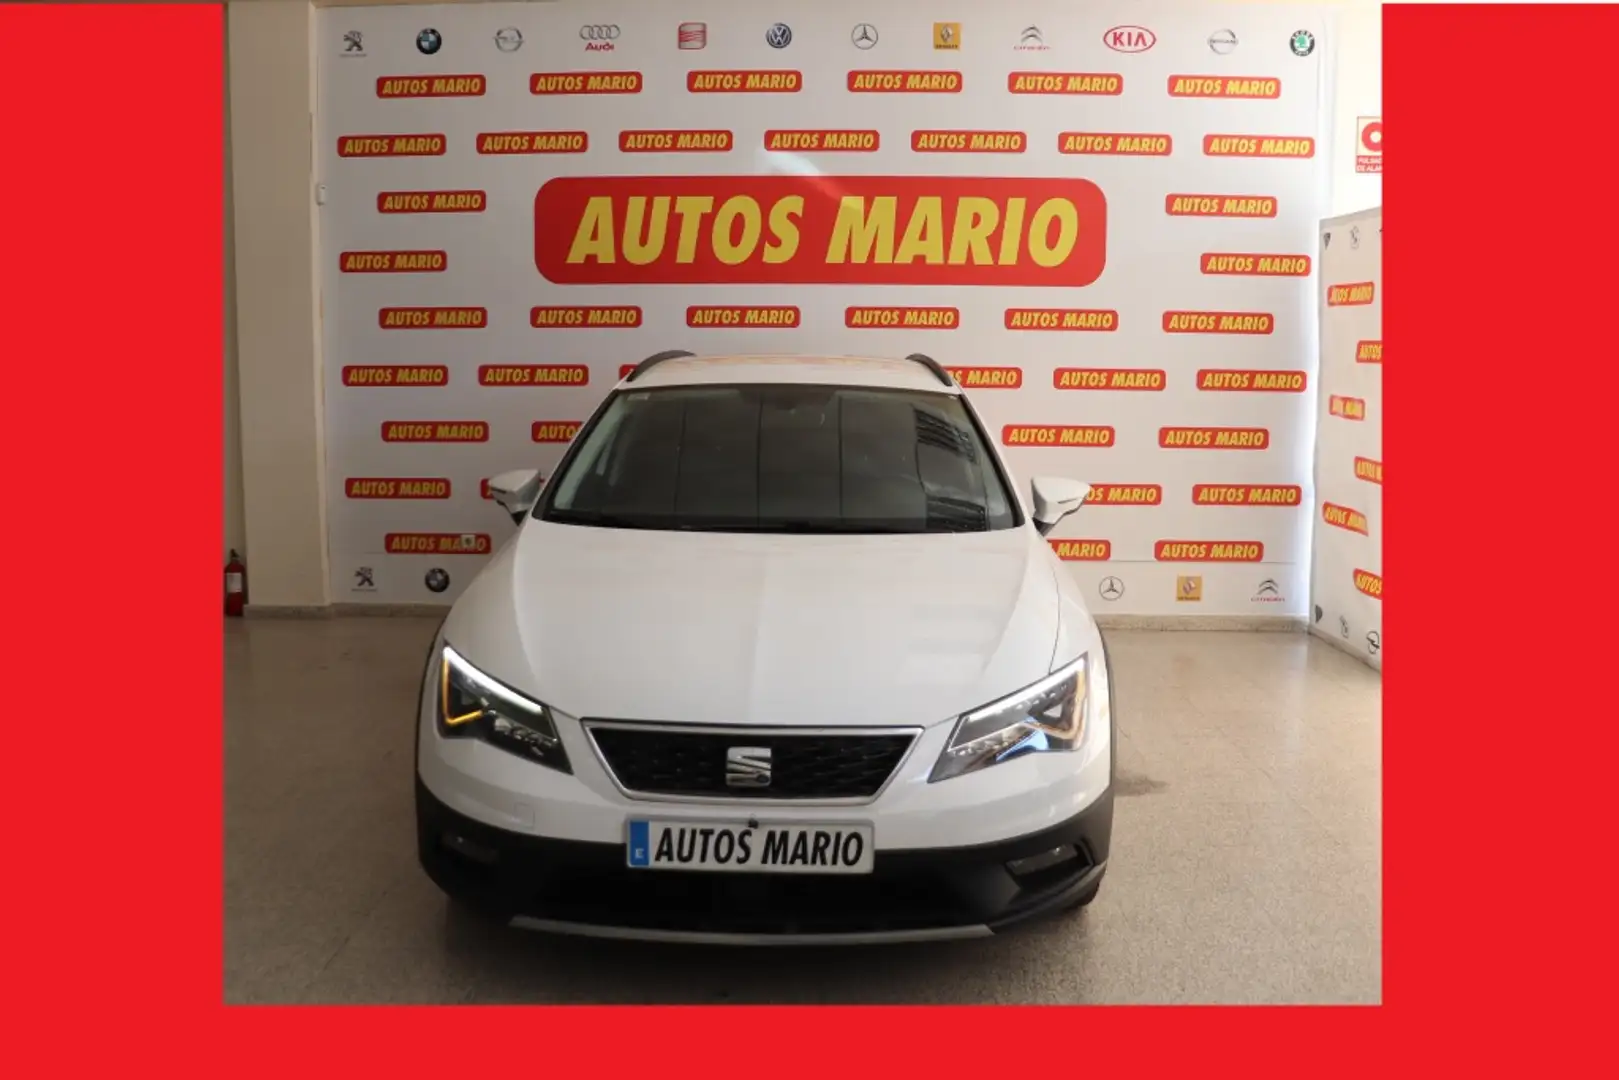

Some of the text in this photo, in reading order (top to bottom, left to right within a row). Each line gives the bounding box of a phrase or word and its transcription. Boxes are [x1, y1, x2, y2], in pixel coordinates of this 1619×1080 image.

[584, 42, 615, 51] Audi
[1113, 32, 1147, 47] KIA
[382, 78, 481, 94] AUTOS MARIO
[536, 75, 638, 91] AUTOS MARIO
[693, 74, 798, 89] AUTOS MARIO
[853, 73, 959, 90] AUTOS MARIO
[1014, 76, 1119, 92] AUTOS MARIO
[1174, 78, 1276, 96] AUTOS MARIO
[342, 138, 441, 154] AUTOS MARIO
[482, 135, 584, 150] AUTOS MARIO
[625, 132, 729, 148] AUTOS MARIO
[770, 133, 875, 148] AUTOS MARIO
[917, 133, 1022, 150] AUTOS MARIO
[1063, 136, 1168, 152] AUTOS MARIO
[1209, 138, 1310, 155] AUTOS MARIO
[383, 194, 481, 210] AUTOS MARIO
[1171, 197, 1273, 215] AUTOS MARIO
[566, 195, 1079, 268] AUTOS MARIO
[345, 254, 442, 270] AUTOS MARIO
[1206, 256, 1306, 273] AUTOS MARIO
[385, 310, 482, 326] AUTOS MARIO
[536, 309, 638, 324] AUTOS MARIO
[692, 309, 796, 324] AUTOS MARIO
[850, 310, 956, 325] AUTOS MARIO
[1010, 312, 1114, 328] AUTOS MARIO
[1167, 314, 1270, 331] AUTOS MARIO
[347, 368, 443, 384] AUTOS MARIO
[484, 367, 584, 383] AUTOS MARIO
[967, 369, 1017, 385] MARIO
[1058, 372, 1163, 387] AUTOS MARIO
[1202, 373, 1303, 389] AUTOS MARIO
[387, 424, 483, 439] AUTOS MARIO
[1007, 428, 1111, 444] AUTOS MARIO
[1163, 430, 1266, 446] AUTOS MARIO
[351, 480, 446, 496] AUTOS MARIO
[1107, 485, 1157, 502] MARIO
[1198, 487, 1297, 503] AUTOS MARIO
[391, 535, 486, 552] AUTOS MAO
[1057, 542, 1106, 558] MARIO
[1159, 543, 1260, 559] AUTOS MARIO
[655, 827, 864, 866] AUTOS MARIO
